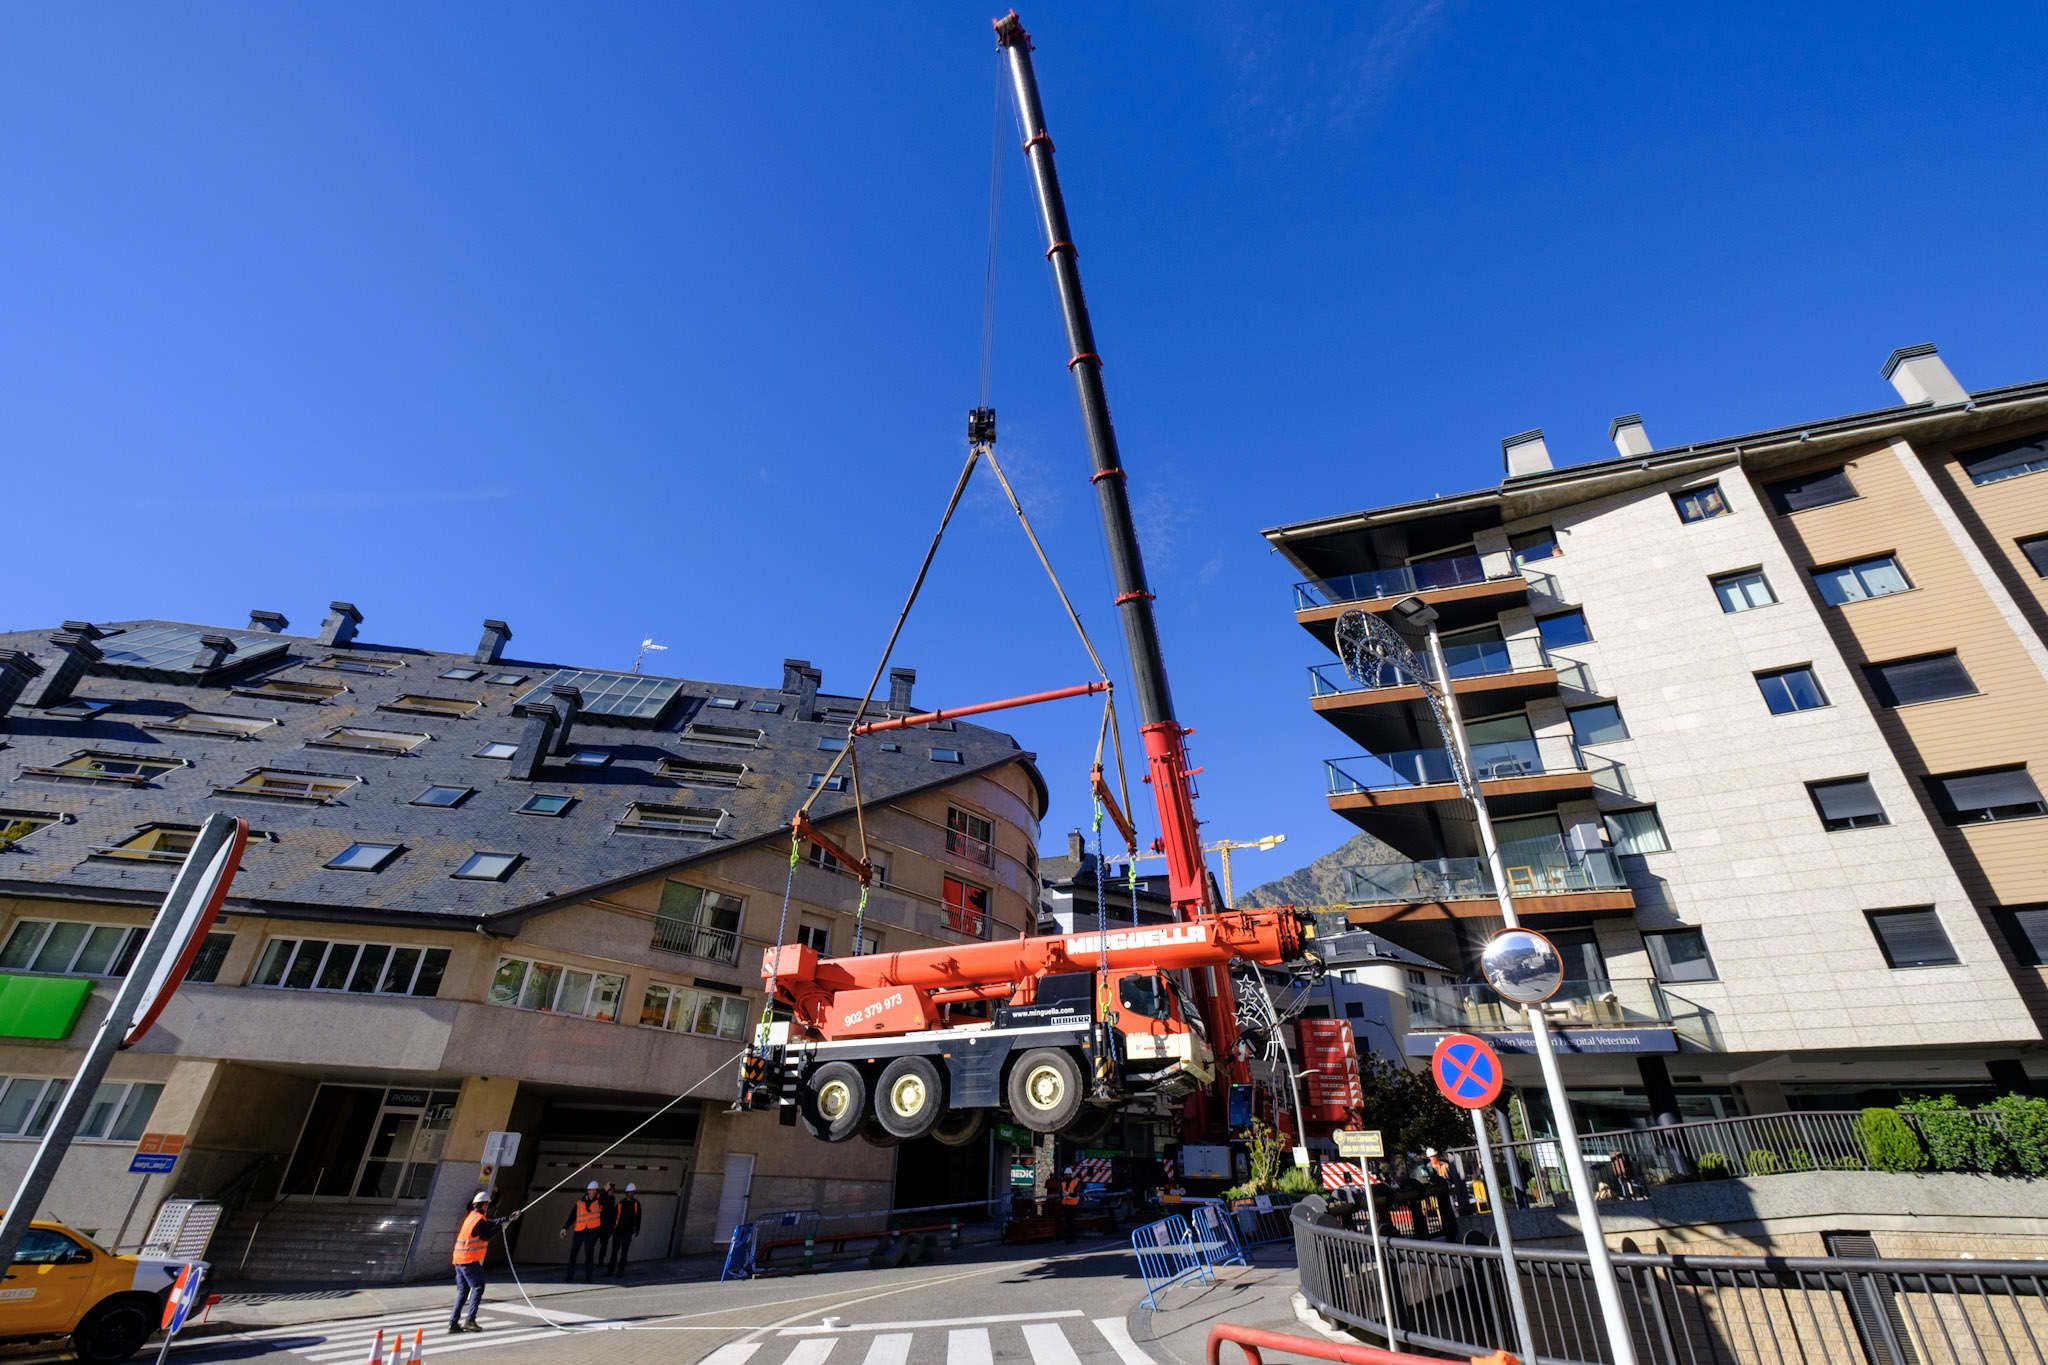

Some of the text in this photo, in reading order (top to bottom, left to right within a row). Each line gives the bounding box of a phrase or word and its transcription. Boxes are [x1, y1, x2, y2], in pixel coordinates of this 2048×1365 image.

[1067, 925, 1206, 955] MINGUELLA
[844, 993, 903, 1027] 902 379 973
[1012, 1007, 1075, 1018] www.minguella.com
[1052, 1015, 1090, 1025] LIEBHERR
[1558, 1036, 1596, 1048] Hspital
[1596, 1035, 1641, 1047] Veterinari
